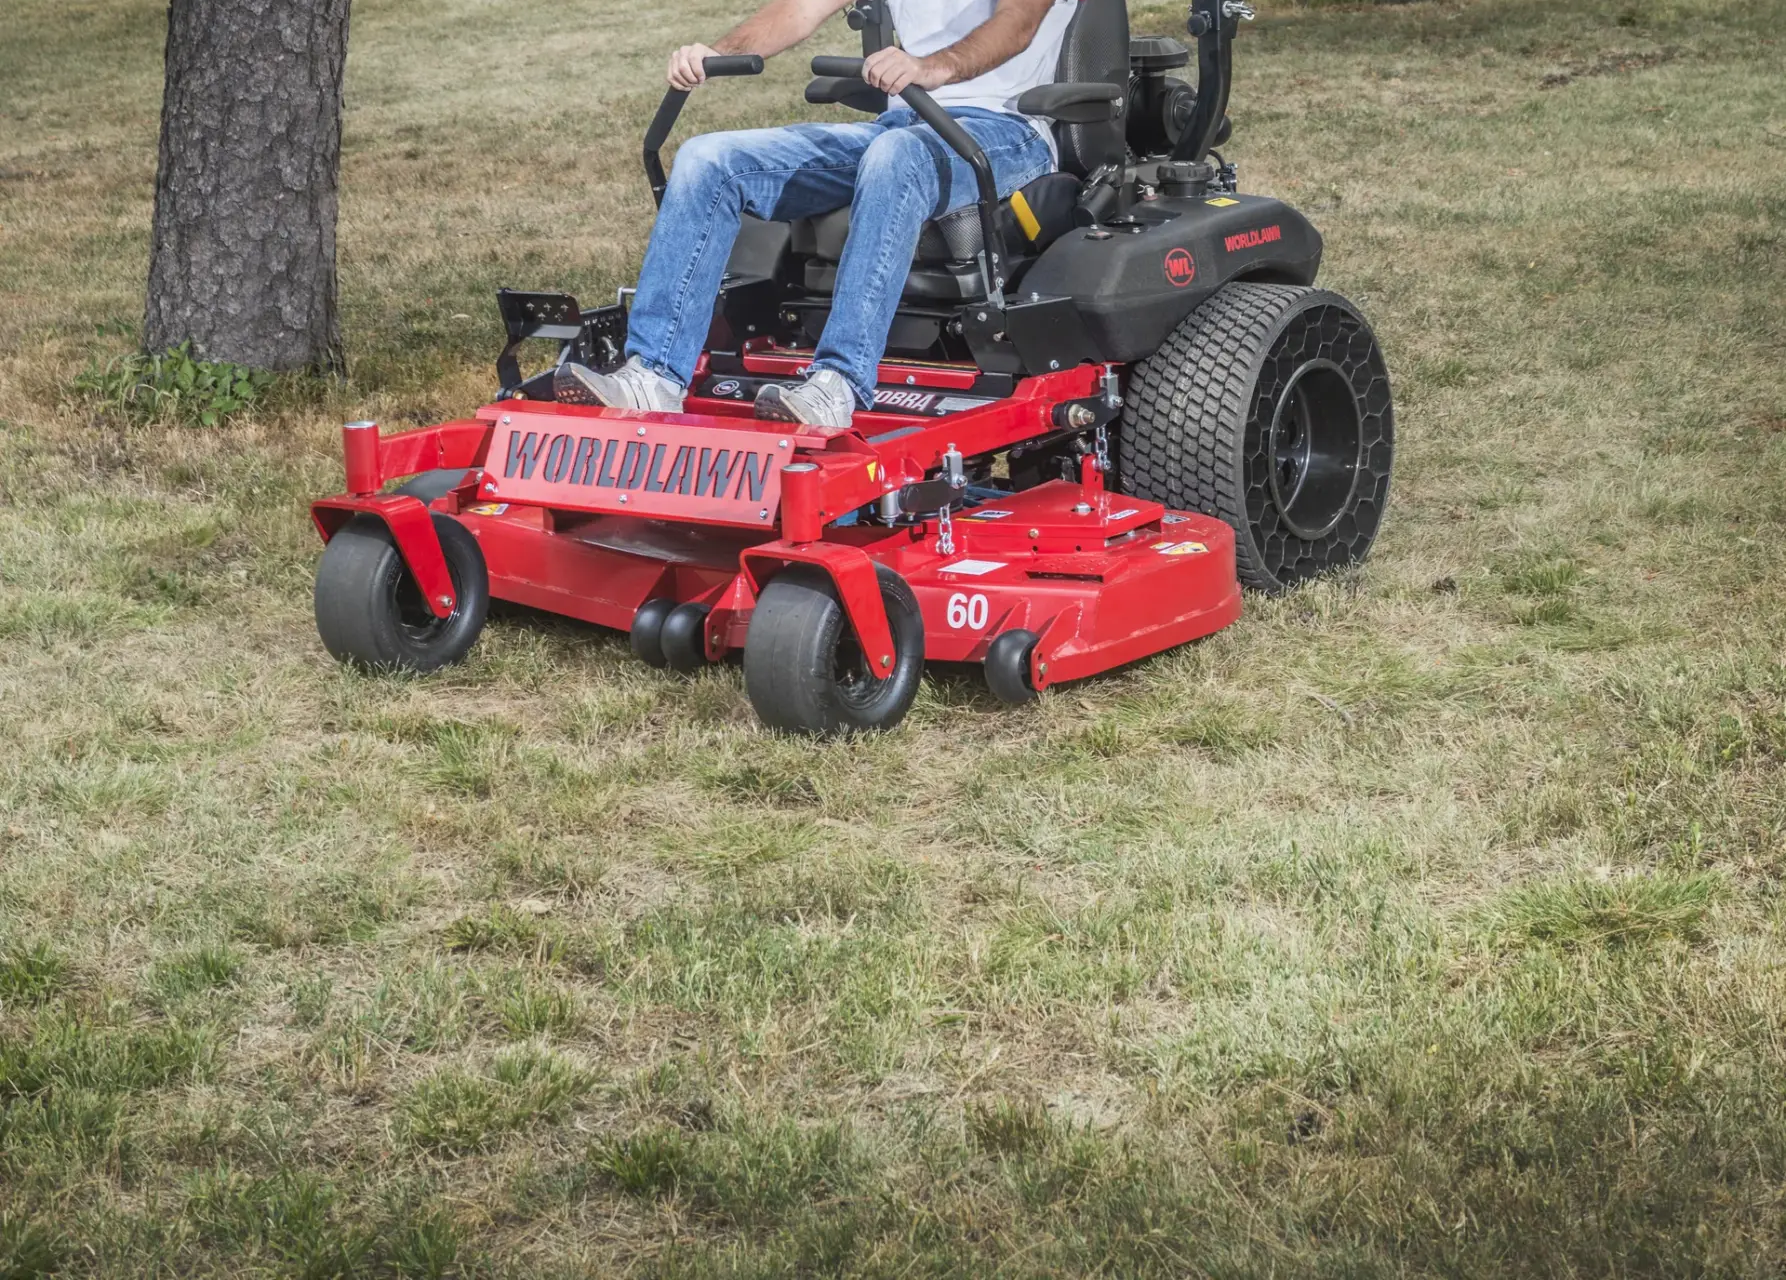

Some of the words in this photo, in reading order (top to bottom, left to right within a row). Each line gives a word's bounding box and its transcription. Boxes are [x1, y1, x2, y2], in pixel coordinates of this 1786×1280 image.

[1224, 225, 1281, 252] WORLDLAWN
[1168, 257, 1191, 278] WL
[503, 430, 774, 502] WORLDLAWN
[947, 593, 988, 630] 60
